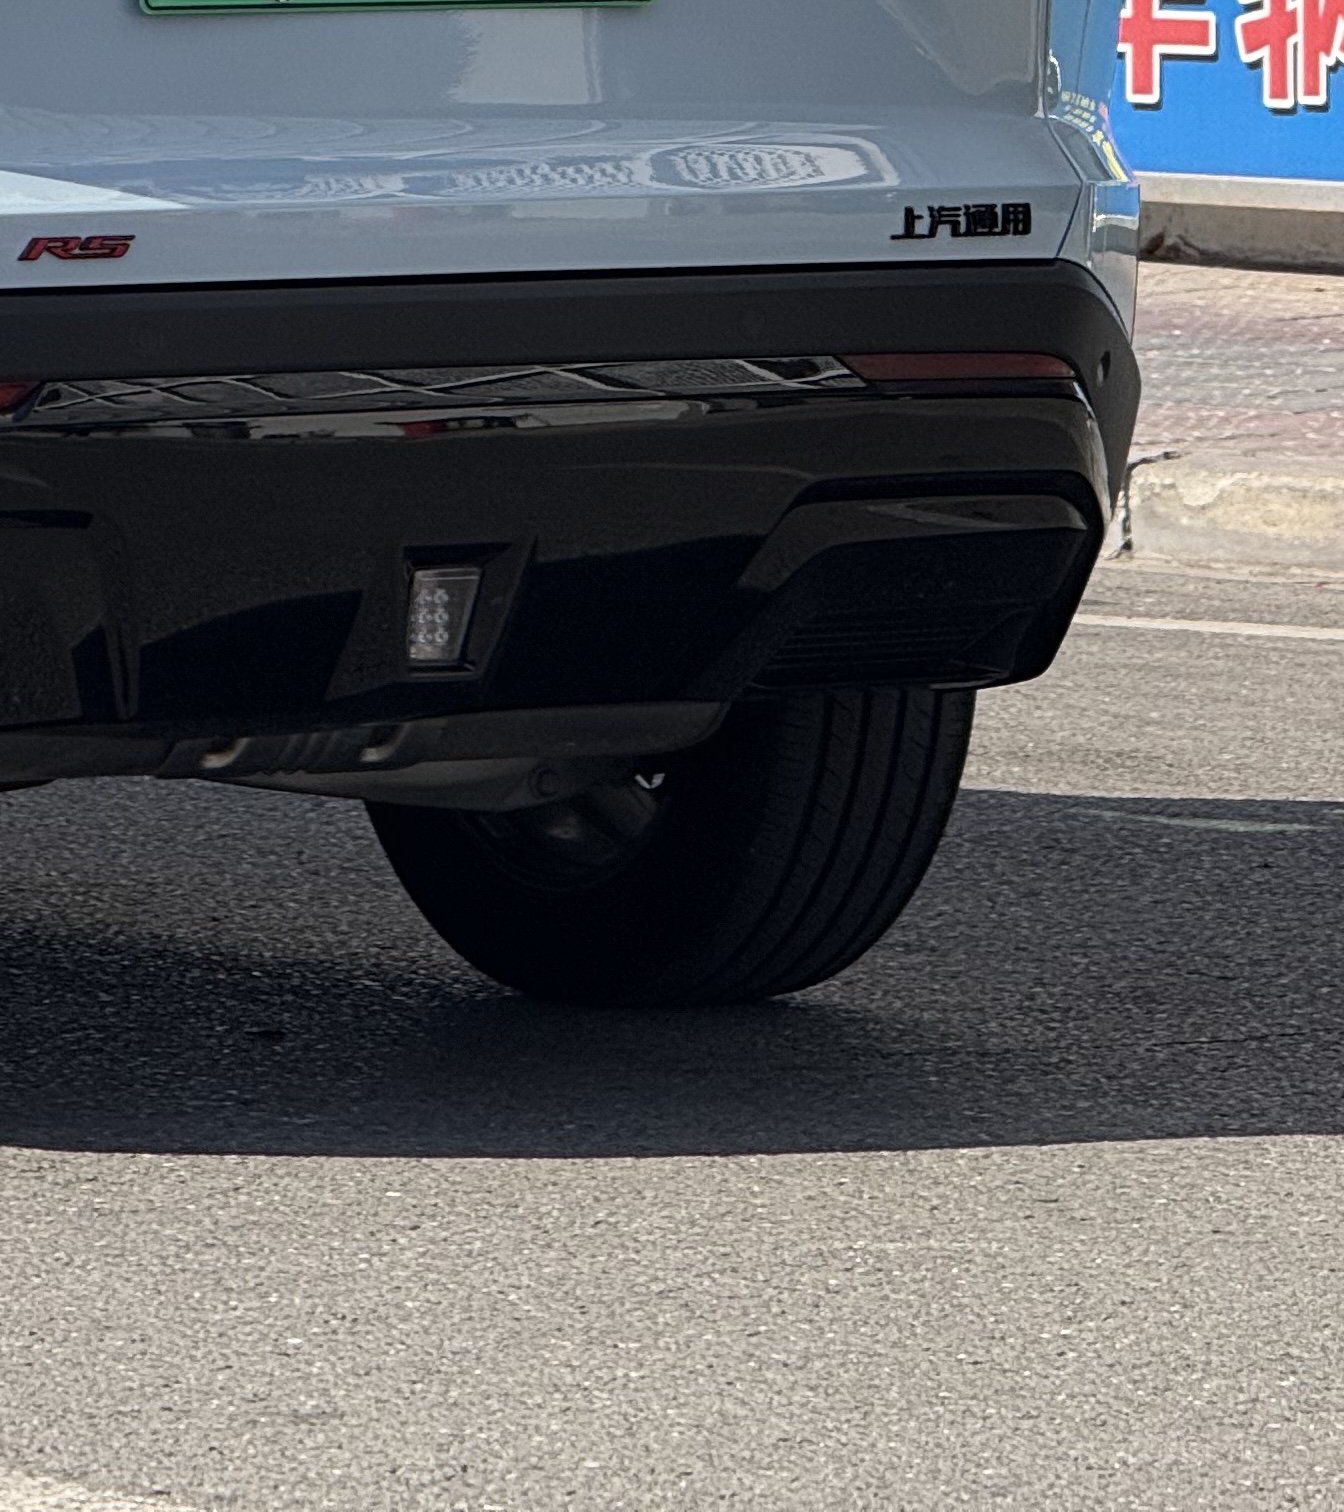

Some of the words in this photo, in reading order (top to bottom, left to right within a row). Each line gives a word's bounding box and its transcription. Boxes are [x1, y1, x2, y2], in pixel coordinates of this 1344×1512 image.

[889, 202, 1033, 240] 上汽通用
[16, 234, 136, 262] RS
